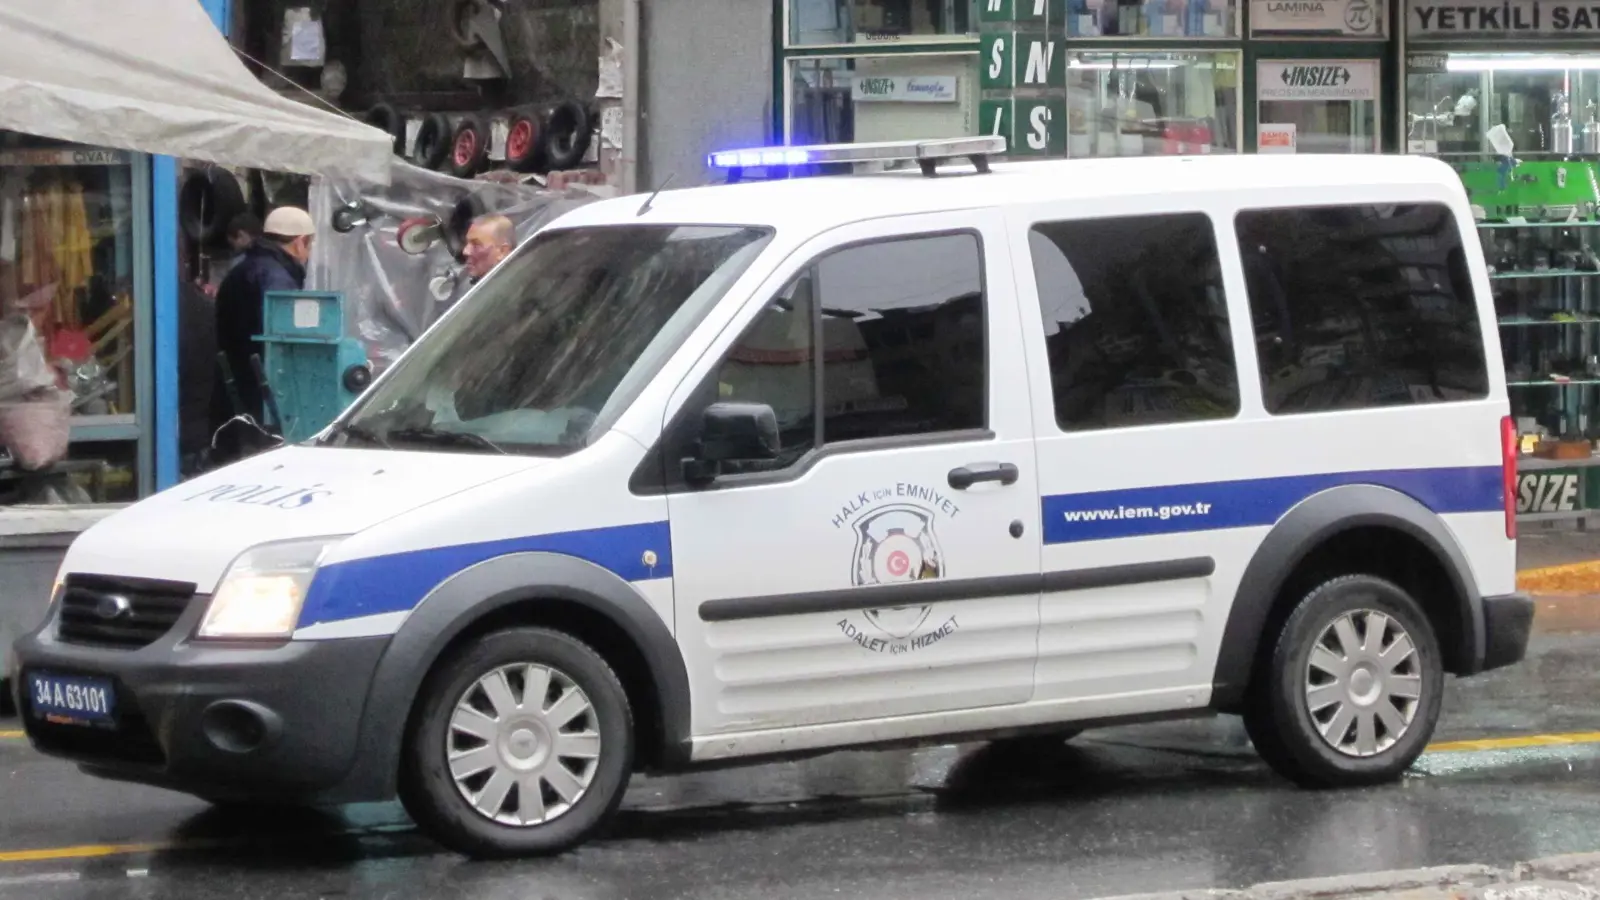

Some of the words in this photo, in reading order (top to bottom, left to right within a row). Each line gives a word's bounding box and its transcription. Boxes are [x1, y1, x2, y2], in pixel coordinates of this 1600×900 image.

[1267, 2, 1325, 12] LAMINA
[1414, 1, 1540, 30] YETKİLİ
[1289, 66, 1342, 87] INSIZE
[832, 491, 870, 529] HALK
[896, 482, 960, 519] EMNİYET
[1516, 473, 1578, 513] SIZE
[1063, 502, 1212, 522] www.iem.gov.tr
[836, 618, 889, 653] ADALET
[35, 679, 52, 705] 34
[54, 682, 66, 707] A
[65, 684, 107, 713] 63101
